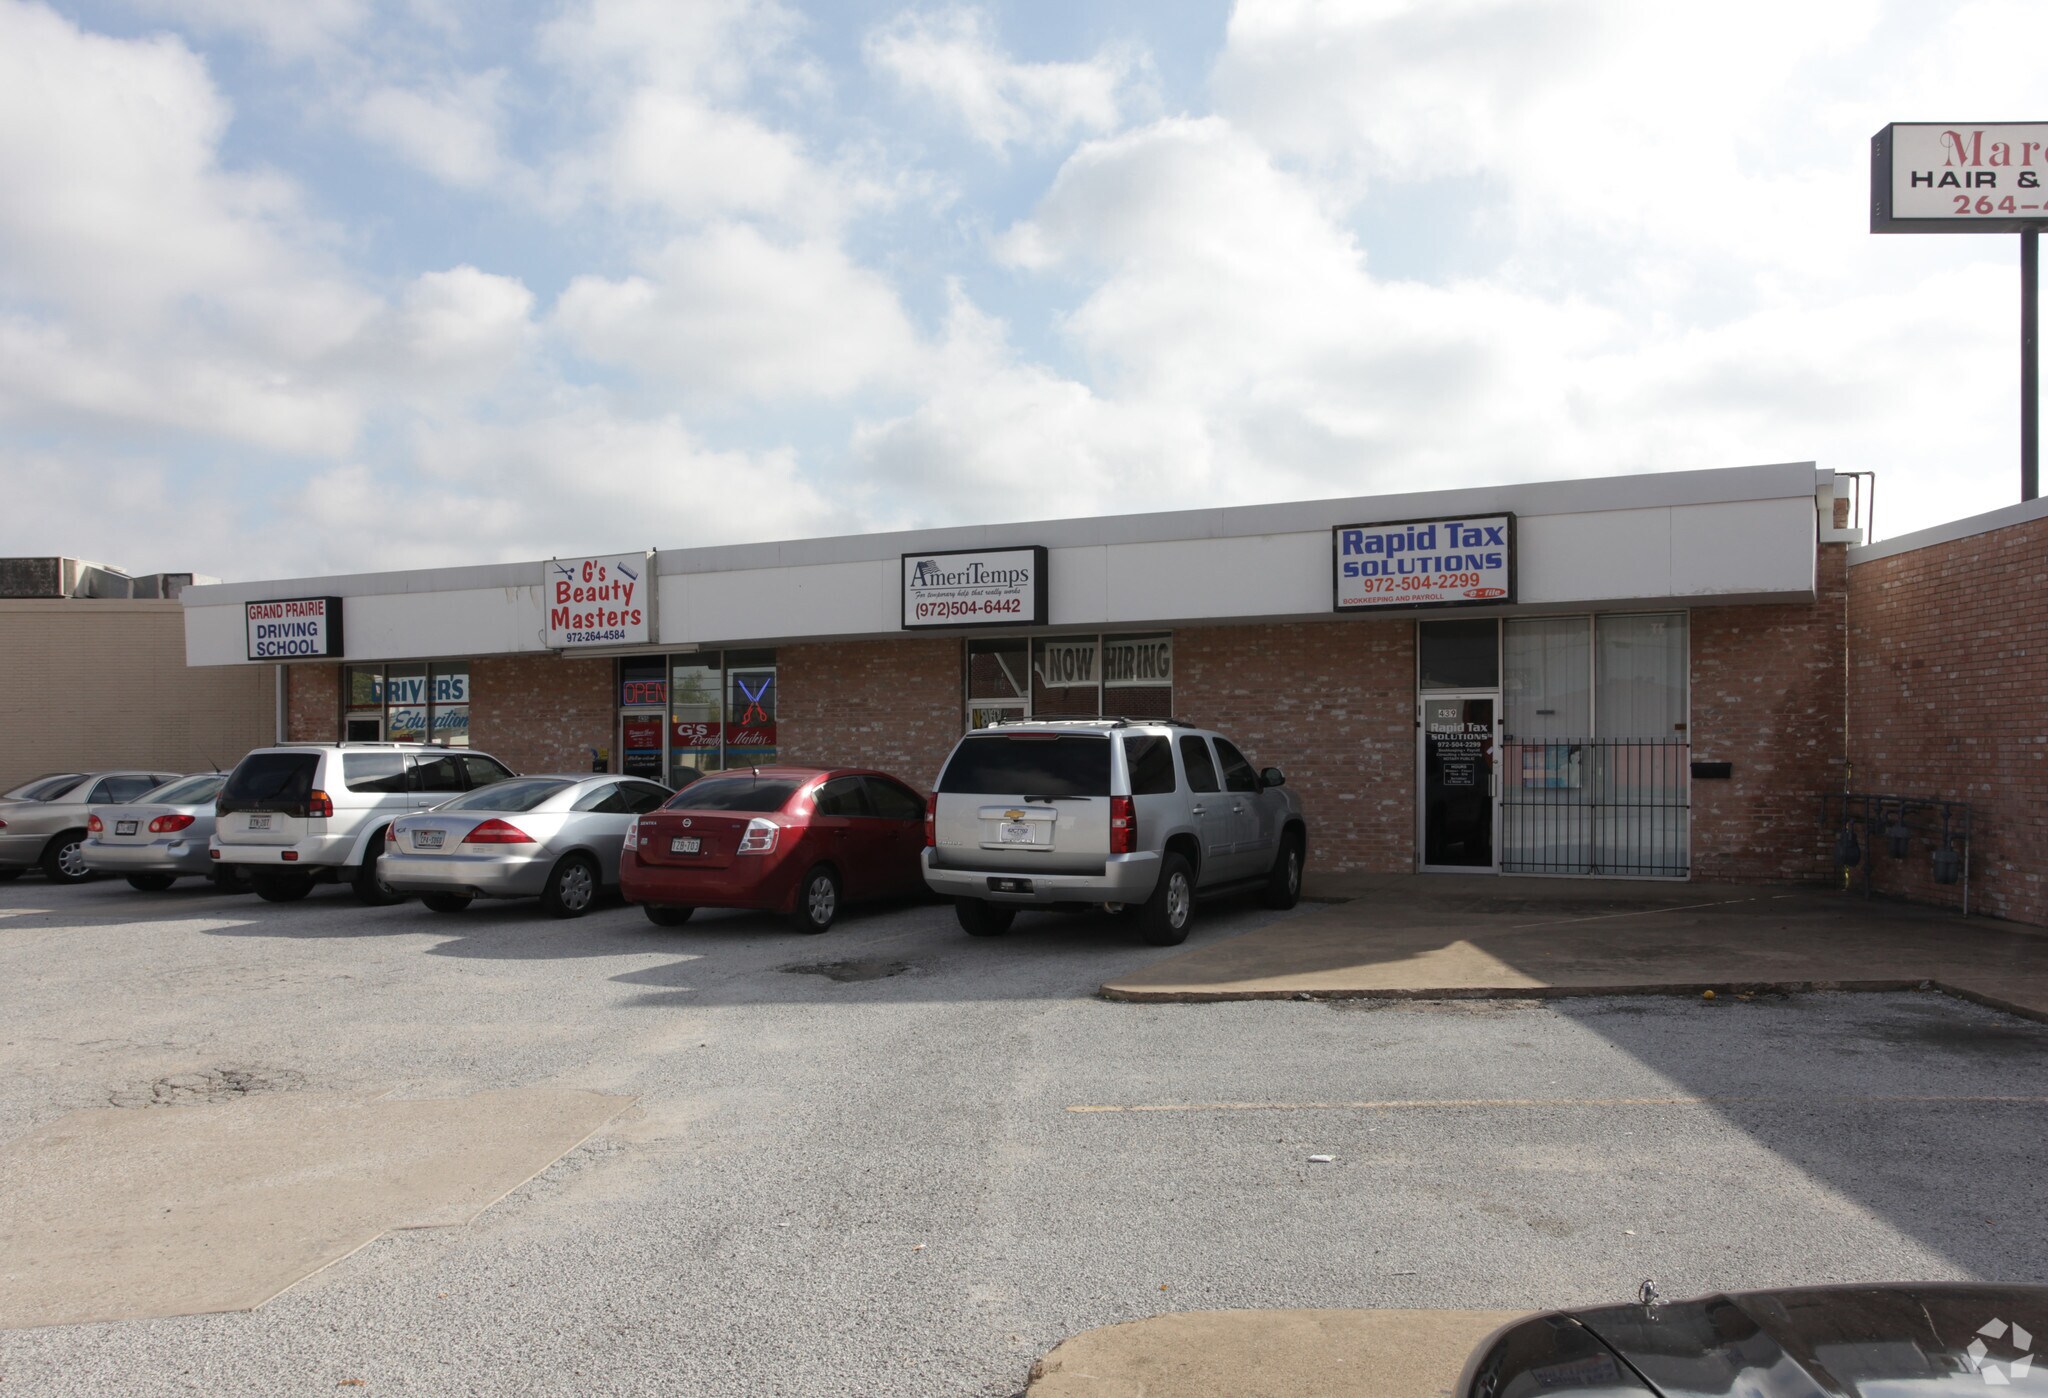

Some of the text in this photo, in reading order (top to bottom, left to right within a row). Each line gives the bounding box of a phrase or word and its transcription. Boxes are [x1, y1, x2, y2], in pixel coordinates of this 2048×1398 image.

[1911, 171, 2041, 188] HAIR &
[1342, 523, 1505, 559] Rapid Tax
[582, 560, 606, 583] G's
[910, 560, 1029, 588] AmeriTemps
[1343, 552, 1503, 578] SOLUTIONS
[1364, 572, 1480, 593] 972-504-2299
[556, 580, 634, 607] Beauty
[915, 591, 926, 600] For
[957, 590, 970, 598] help
[985, 588, 1002, 596] really
[1343, 593, 1445, 605] BOOKKEEPING AND PAYROLL
[249, 601, 324, 620] GRAND PRAIRIE
[551, 606, 642, 631] Masters
[915, 598, 1021, 620] (972)504-6442
[257, 621, 318, 639] DRIVING
[566, 629, 626, 643] 972-264-4584
[256, 639, 319, 656] SCHOOL
[1050, 642, 1170, 682] NOW HIRING
[626, 682, 667, 703] OPEN
[677, 724, 708, 736] G'S
[1430, 722, 1488, 734] Rapid Tax
[1431, 733, 1488, 741] SOLUTIONS
